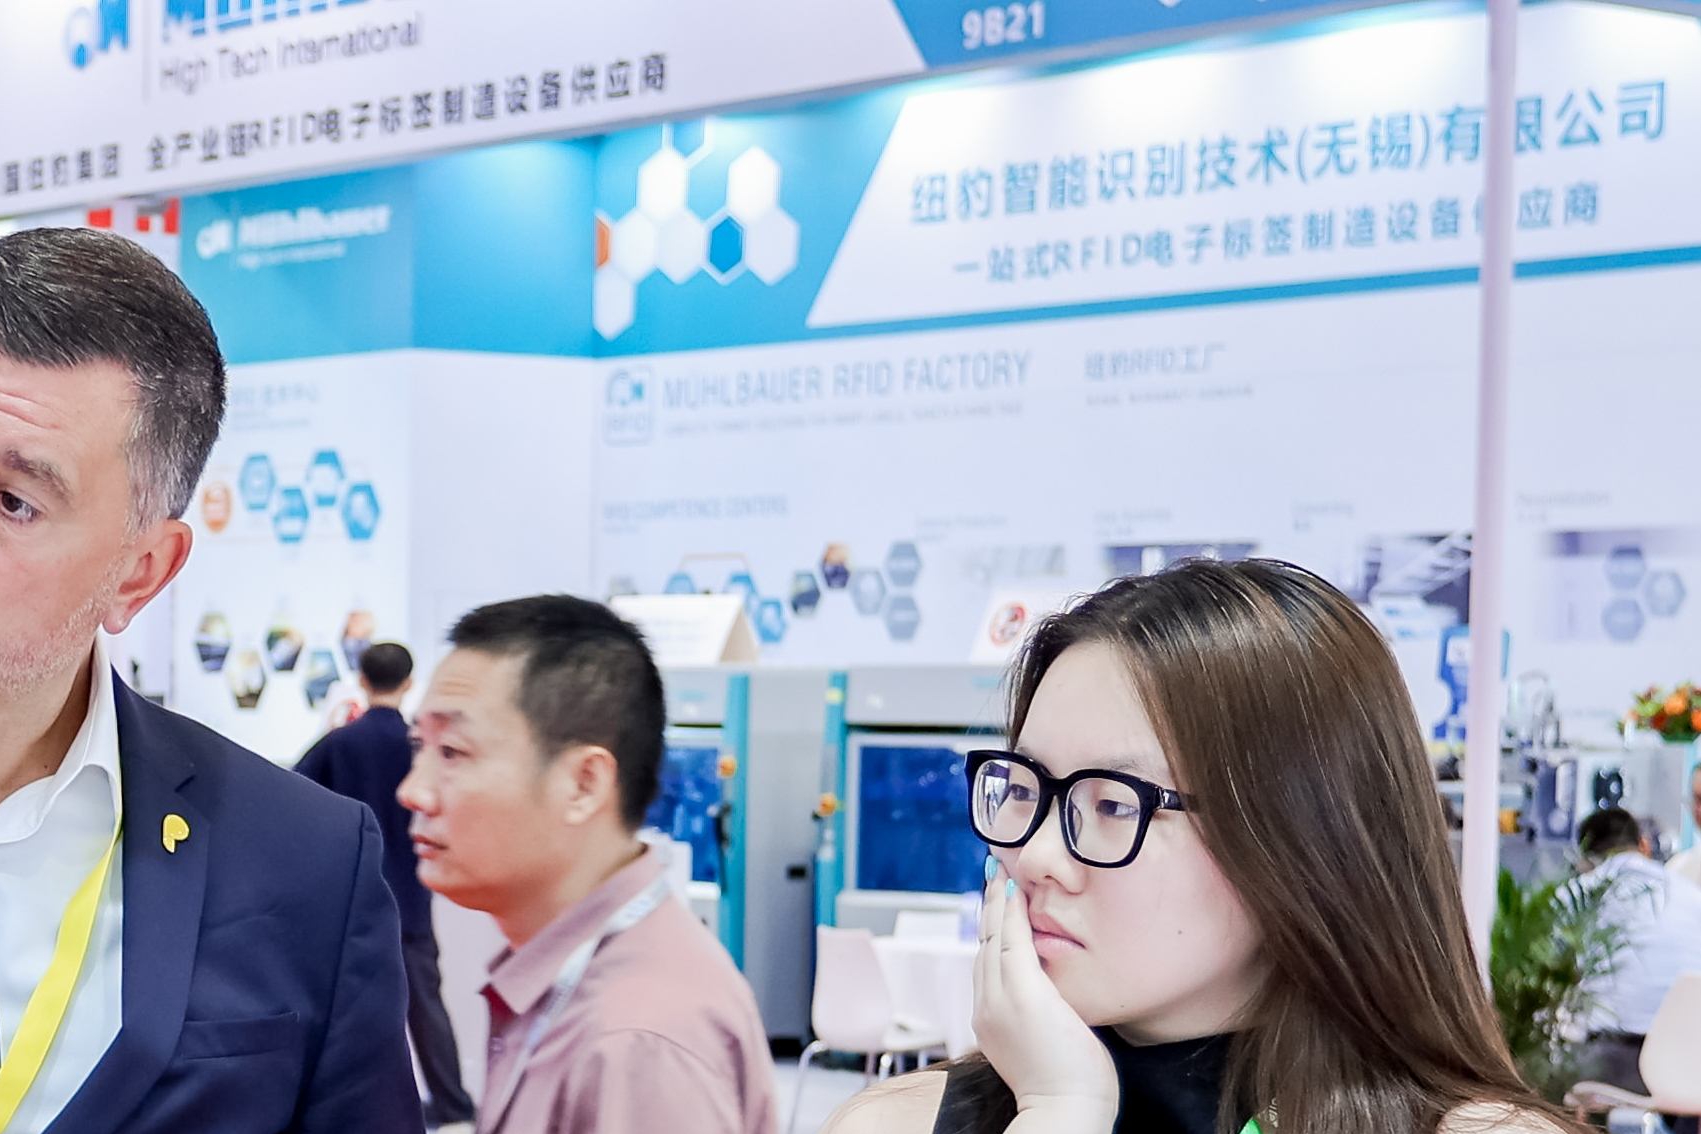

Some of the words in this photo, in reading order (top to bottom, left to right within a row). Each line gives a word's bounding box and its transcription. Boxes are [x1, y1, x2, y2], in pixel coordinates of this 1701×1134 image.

[962, 3, 1045, 51] 9B21
[161, 53, 208, 95] High
[218, 45, 269, 82] Tech
[278, 13, 421, 70] International
[833, 357, 893, 398] RFID
[904, 350, 1033, 393] FACTORY
